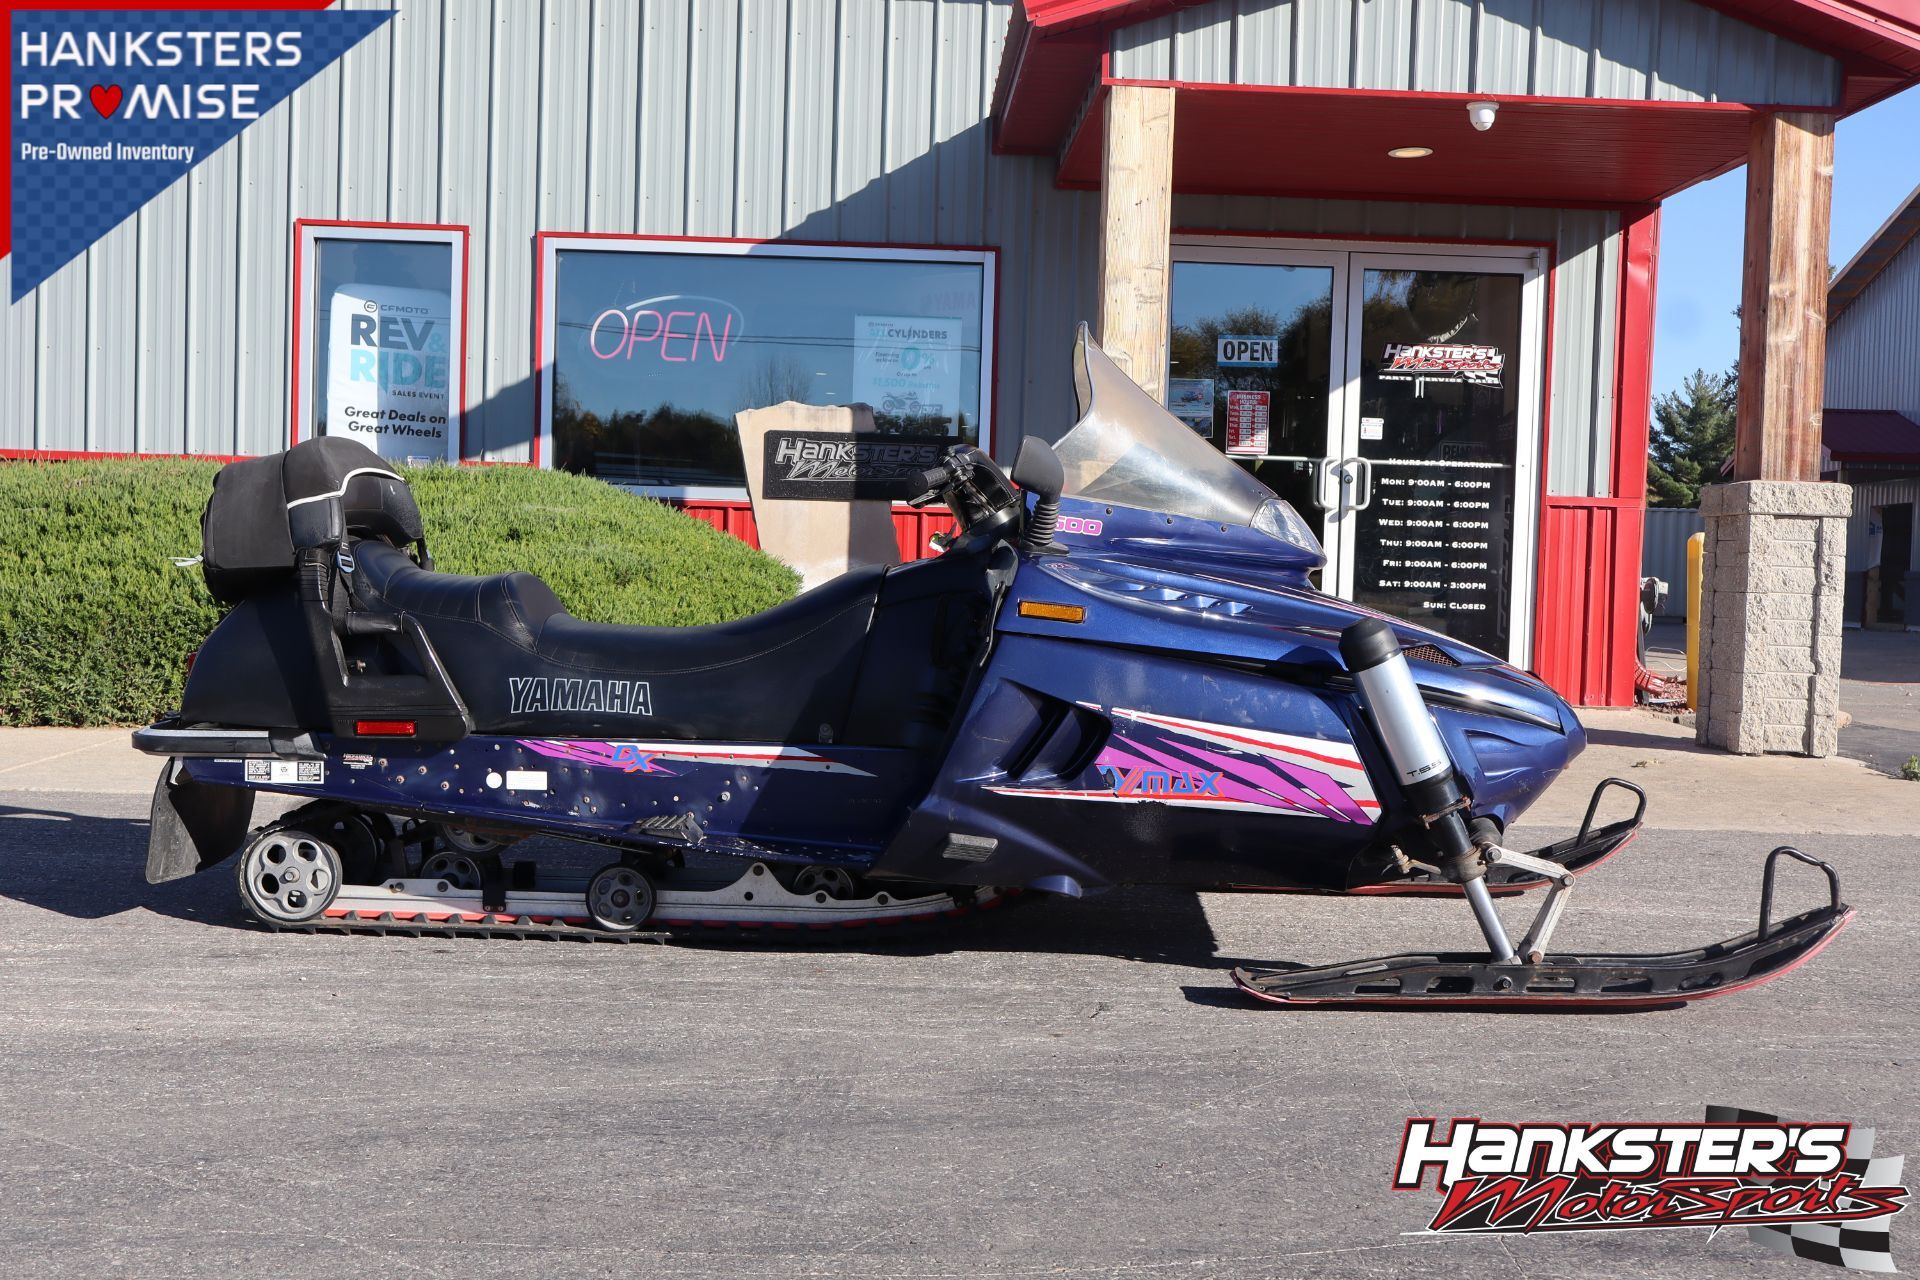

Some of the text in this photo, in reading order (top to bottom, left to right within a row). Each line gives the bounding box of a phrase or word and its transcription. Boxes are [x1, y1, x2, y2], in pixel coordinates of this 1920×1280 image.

[380, 304, 429, 315] CFMOTO
[351, 314, 435, 351] REV
[590, 309, 732, 362] OPEN
[887, 326, 948, 340] CYLINDERS
[1223, 341, 1273, 361] OPEN
[350, 349, 446, 391] RIDE
[392, 389, 445, 400] SALES EVENT
[344, 406, 447, 424] Great Deals on
[348, 421, 442, 438] Great Wheels
[1454, 501, 1490, 509] 6:00PM
[1406, 520, 1443, 528] 9:00AM
[1453, 521, 1488, 529] 6:00PM
[1406, 540, 1442, 548] 9:00AM
[1451, 562, 1487, 570] 6:00PM
[1450, 582, 1486, 590] 3:00PM
[1449, 602, 1486, 610] CLOSED
[509, 677, 653, 716] YAMAHA
[612, 744, 656, 772] DX
